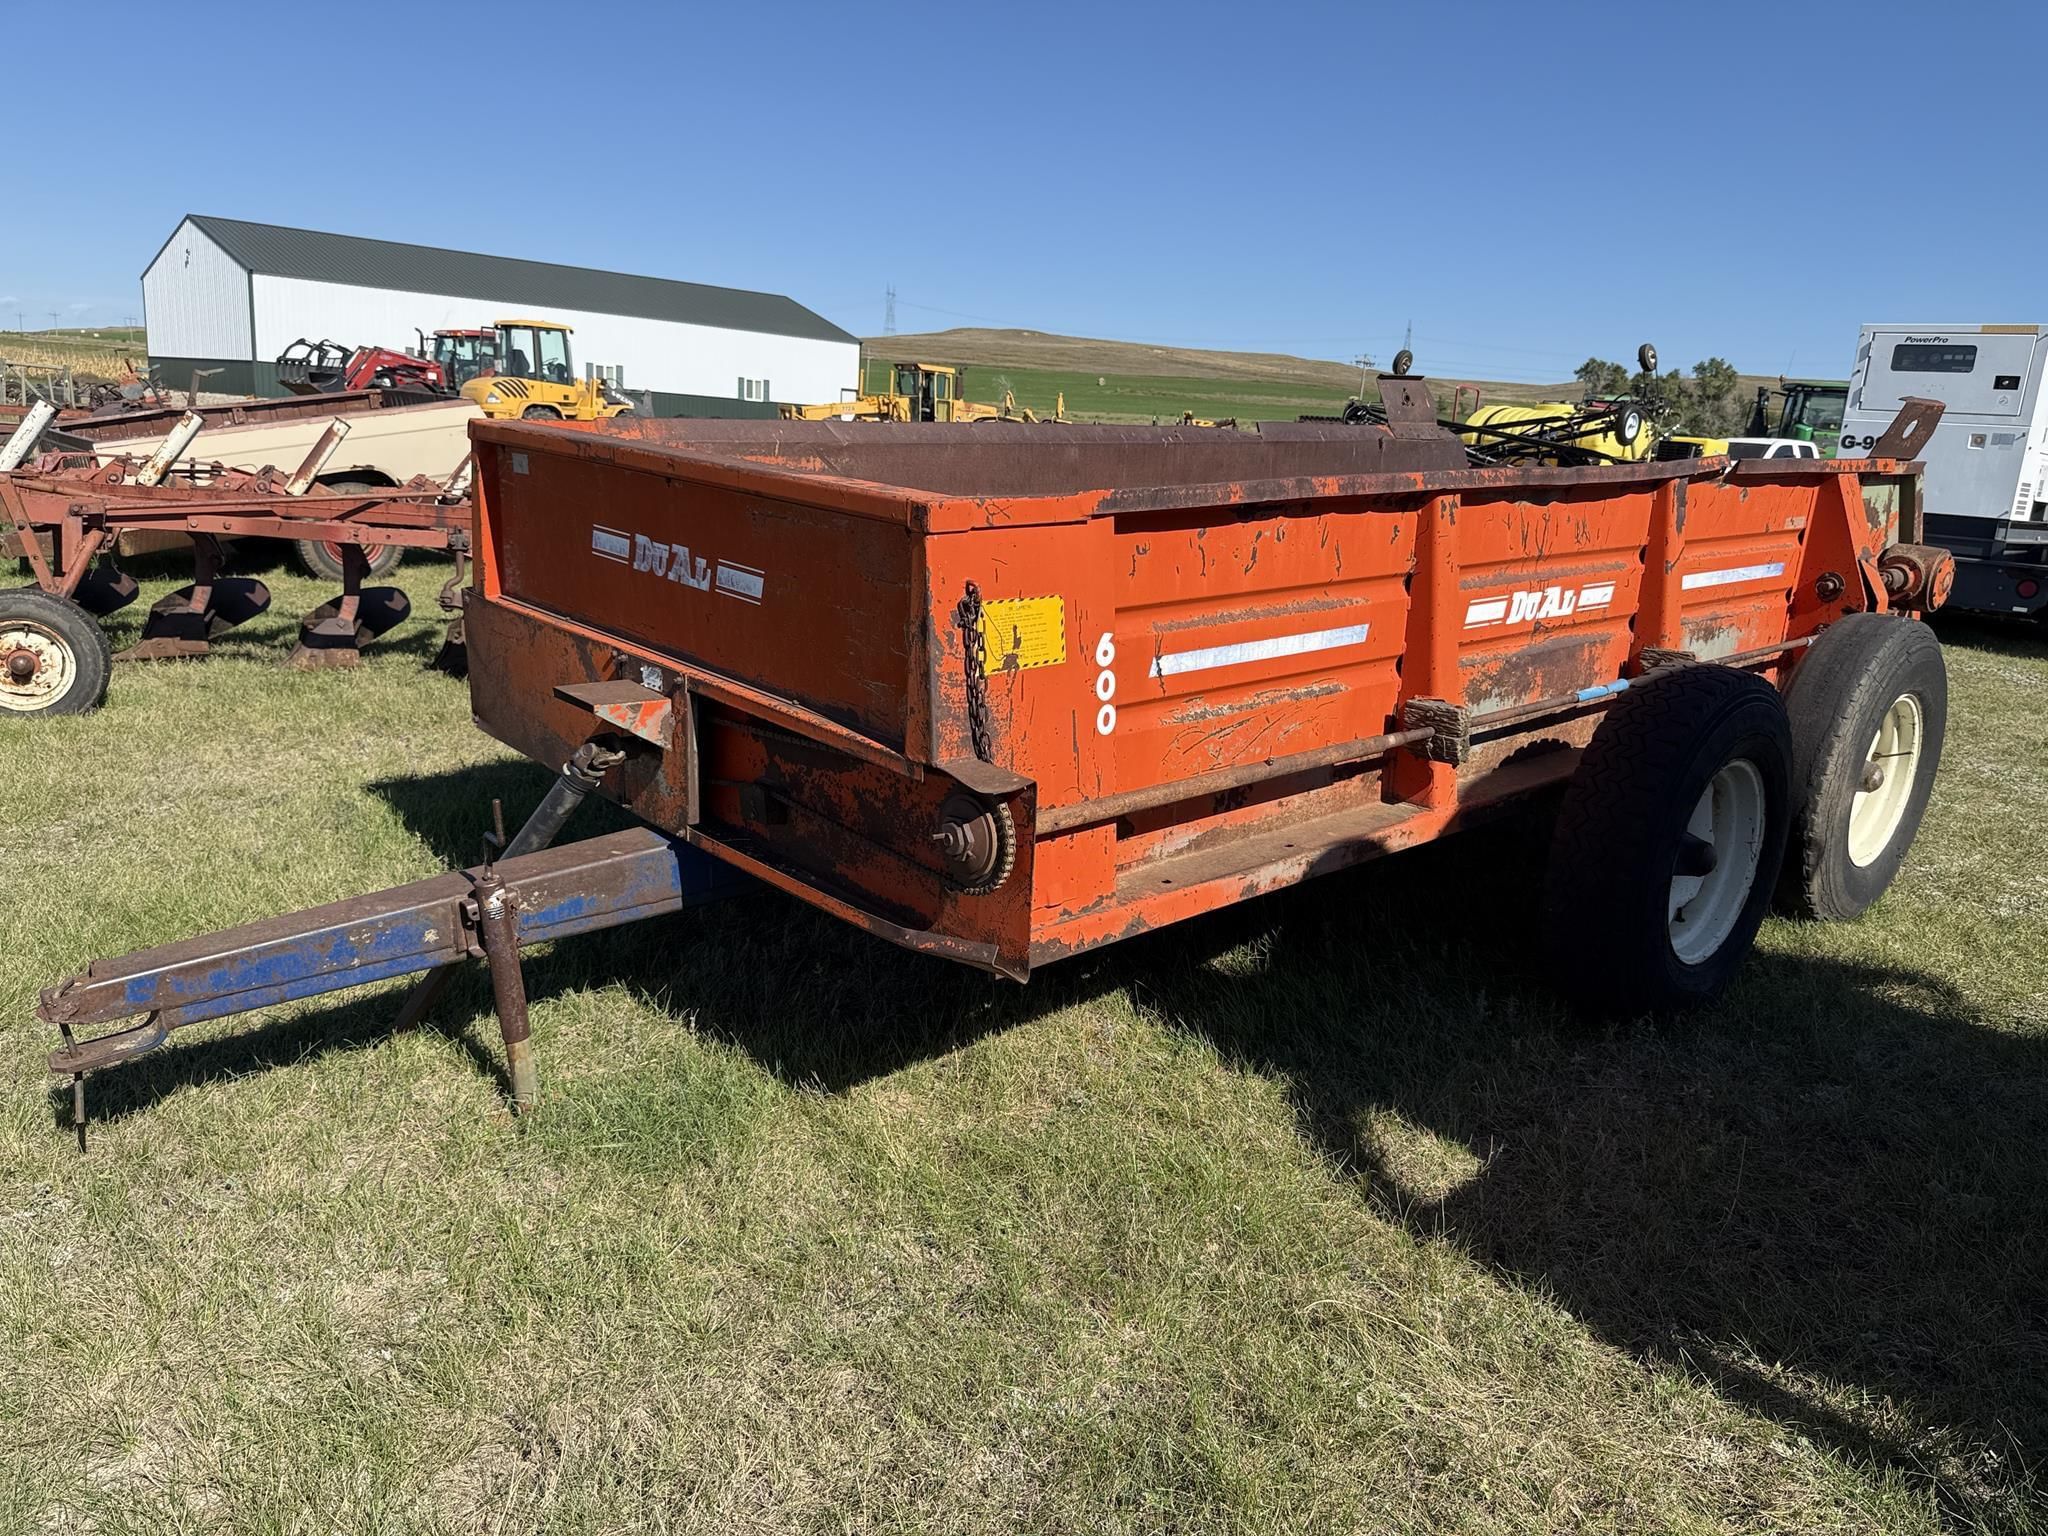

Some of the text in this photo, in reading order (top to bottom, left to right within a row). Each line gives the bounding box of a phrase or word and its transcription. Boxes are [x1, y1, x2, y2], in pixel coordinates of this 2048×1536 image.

[1904, 336, 1949, 344] PowerPro
[1841, 434, 1882, 450] G-9
[1096, 632, 1117, 736] 600
